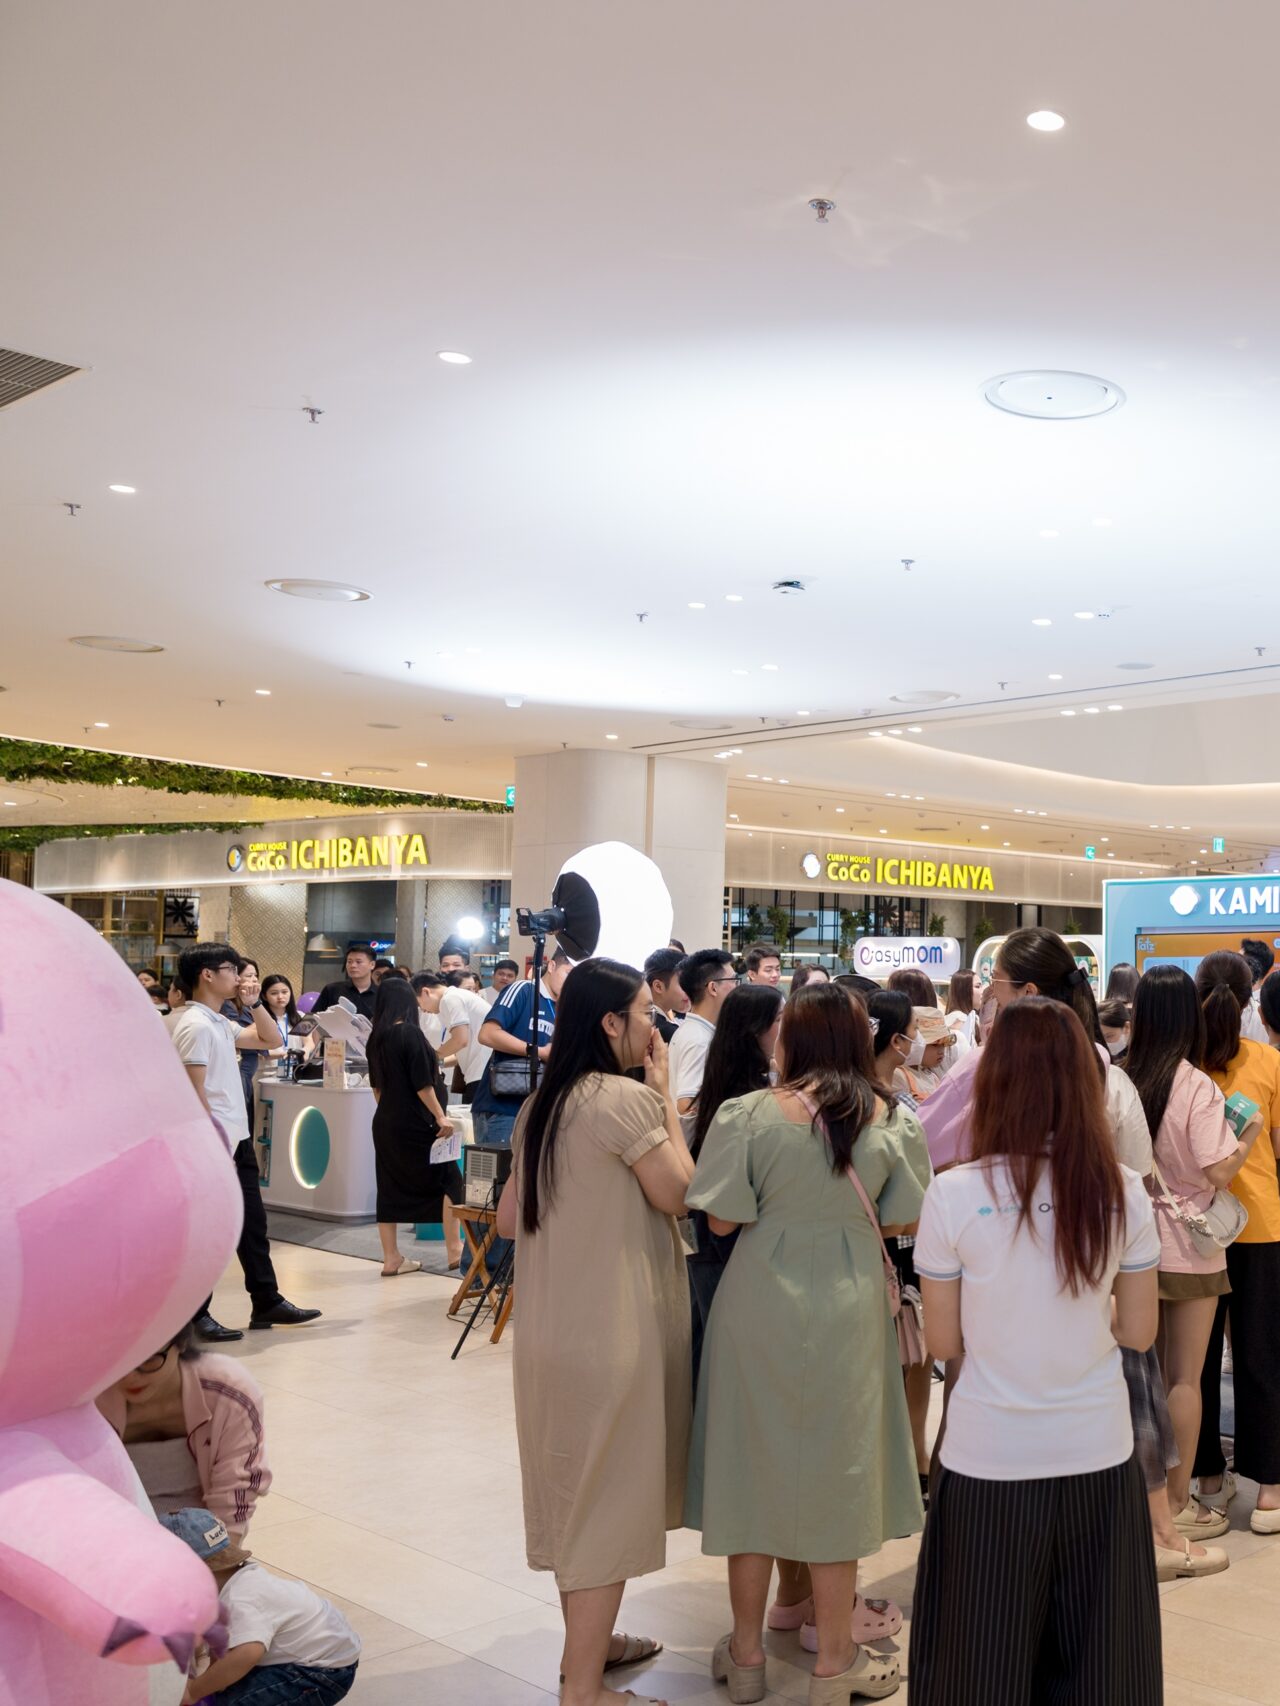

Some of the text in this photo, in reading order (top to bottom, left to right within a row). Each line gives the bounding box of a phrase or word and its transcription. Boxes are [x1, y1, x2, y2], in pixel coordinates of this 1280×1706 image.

[247, 834, 428, 872] CoCo ICHIBANYA
[249, 841, 287, 851] CURRY HOUSE
[826, 853, 871, 864] CURRY HOUSE
[827, 857, 995, 892] CoCo ICHIBANYA
